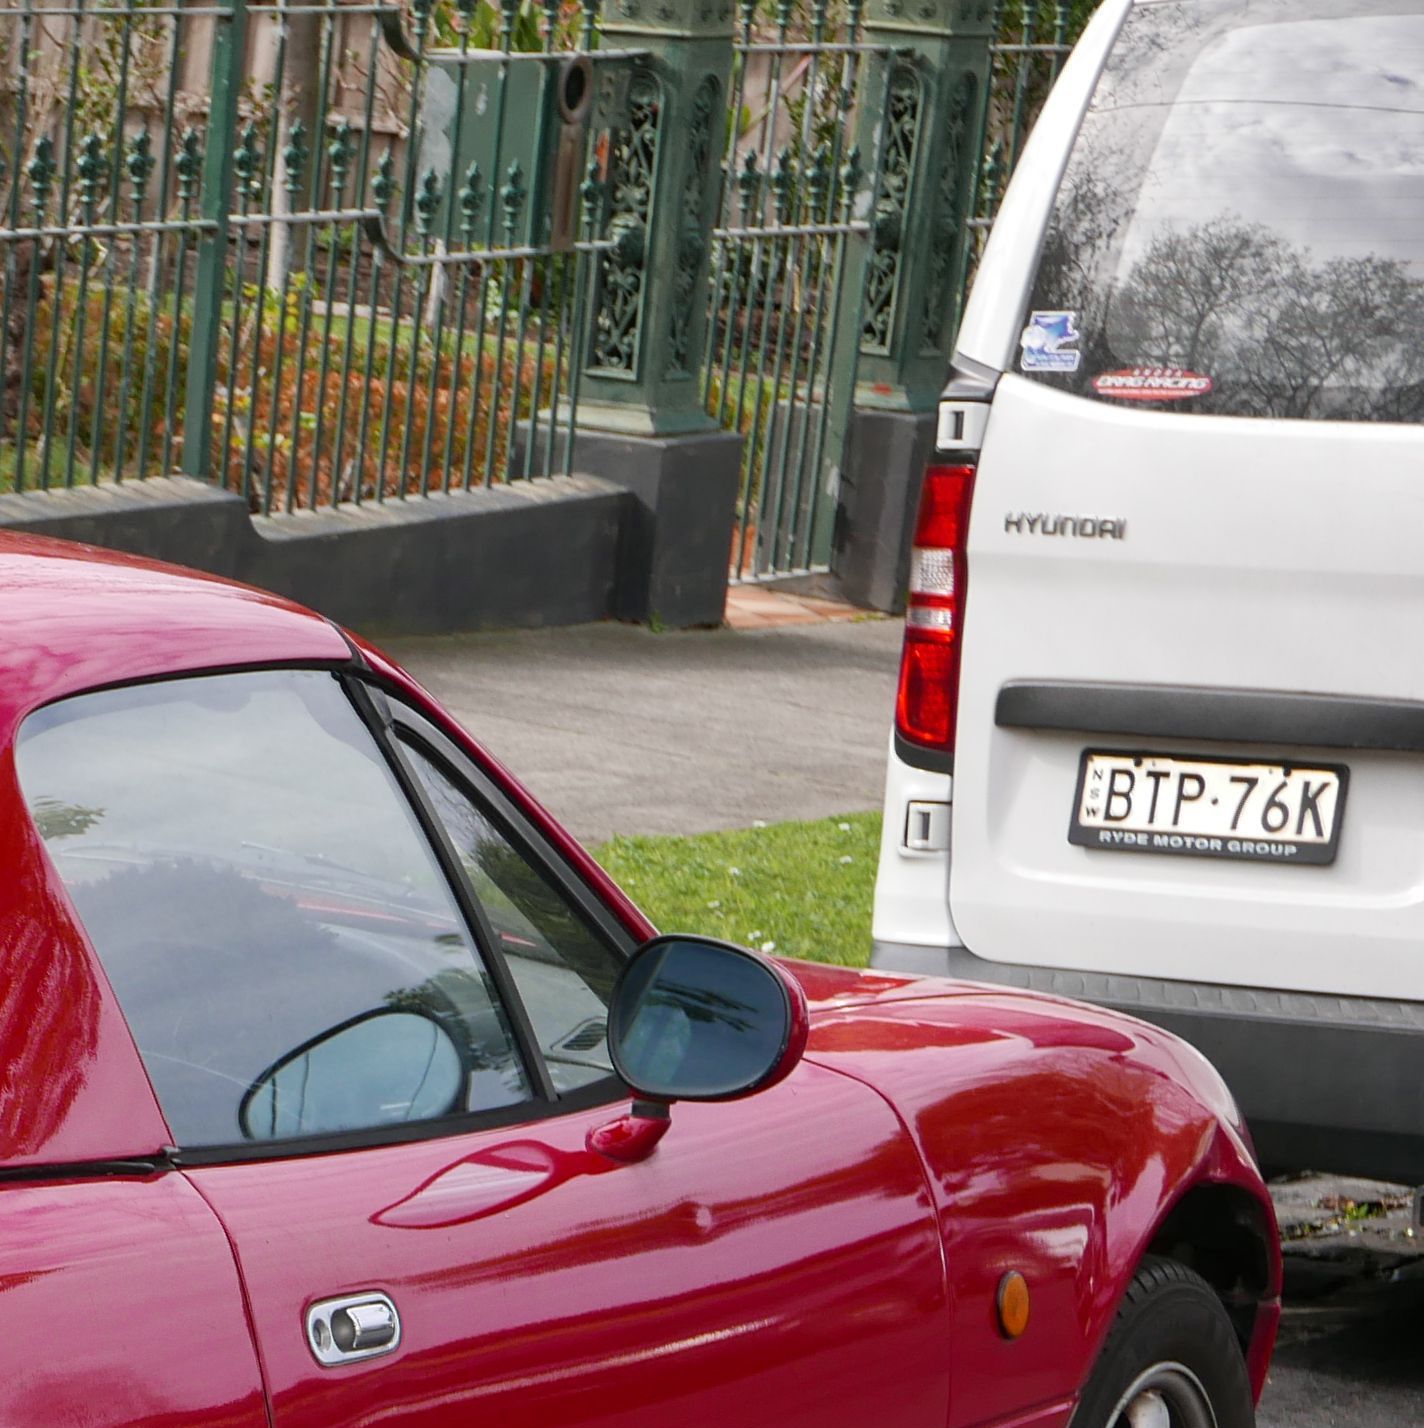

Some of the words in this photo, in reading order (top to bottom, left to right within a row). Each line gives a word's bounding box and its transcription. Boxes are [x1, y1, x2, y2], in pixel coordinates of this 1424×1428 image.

[1004, 511, 1127, 540] HYUNDAI
[1098, 829, 1149, 846] RYDE
[1153, 833, 1223, 852] MOTOR
[1227, 838, 1297, 857] GROUP
